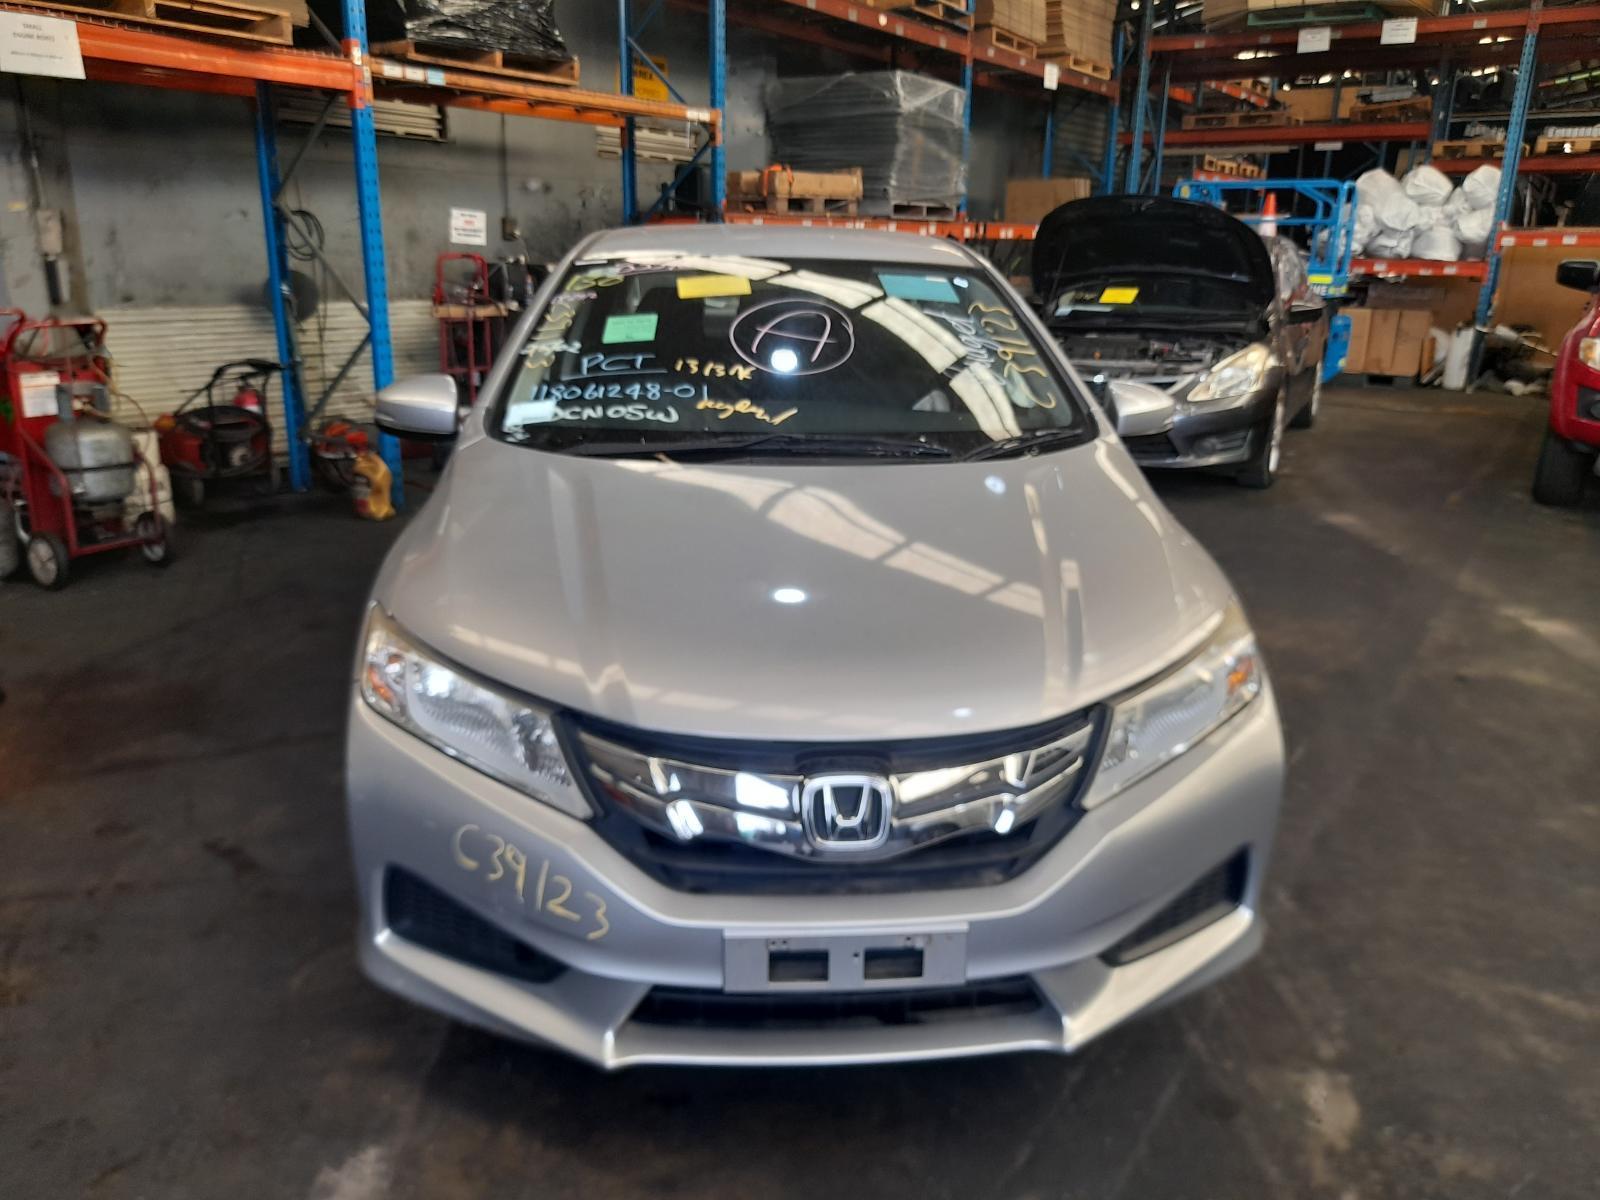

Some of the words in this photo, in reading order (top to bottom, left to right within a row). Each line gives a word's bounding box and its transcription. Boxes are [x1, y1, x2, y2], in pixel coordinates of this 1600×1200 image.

[751, 310, 838, 362] A
[581, 352, 656, 376] PCT
[454, 823, 610, 941] C39123
